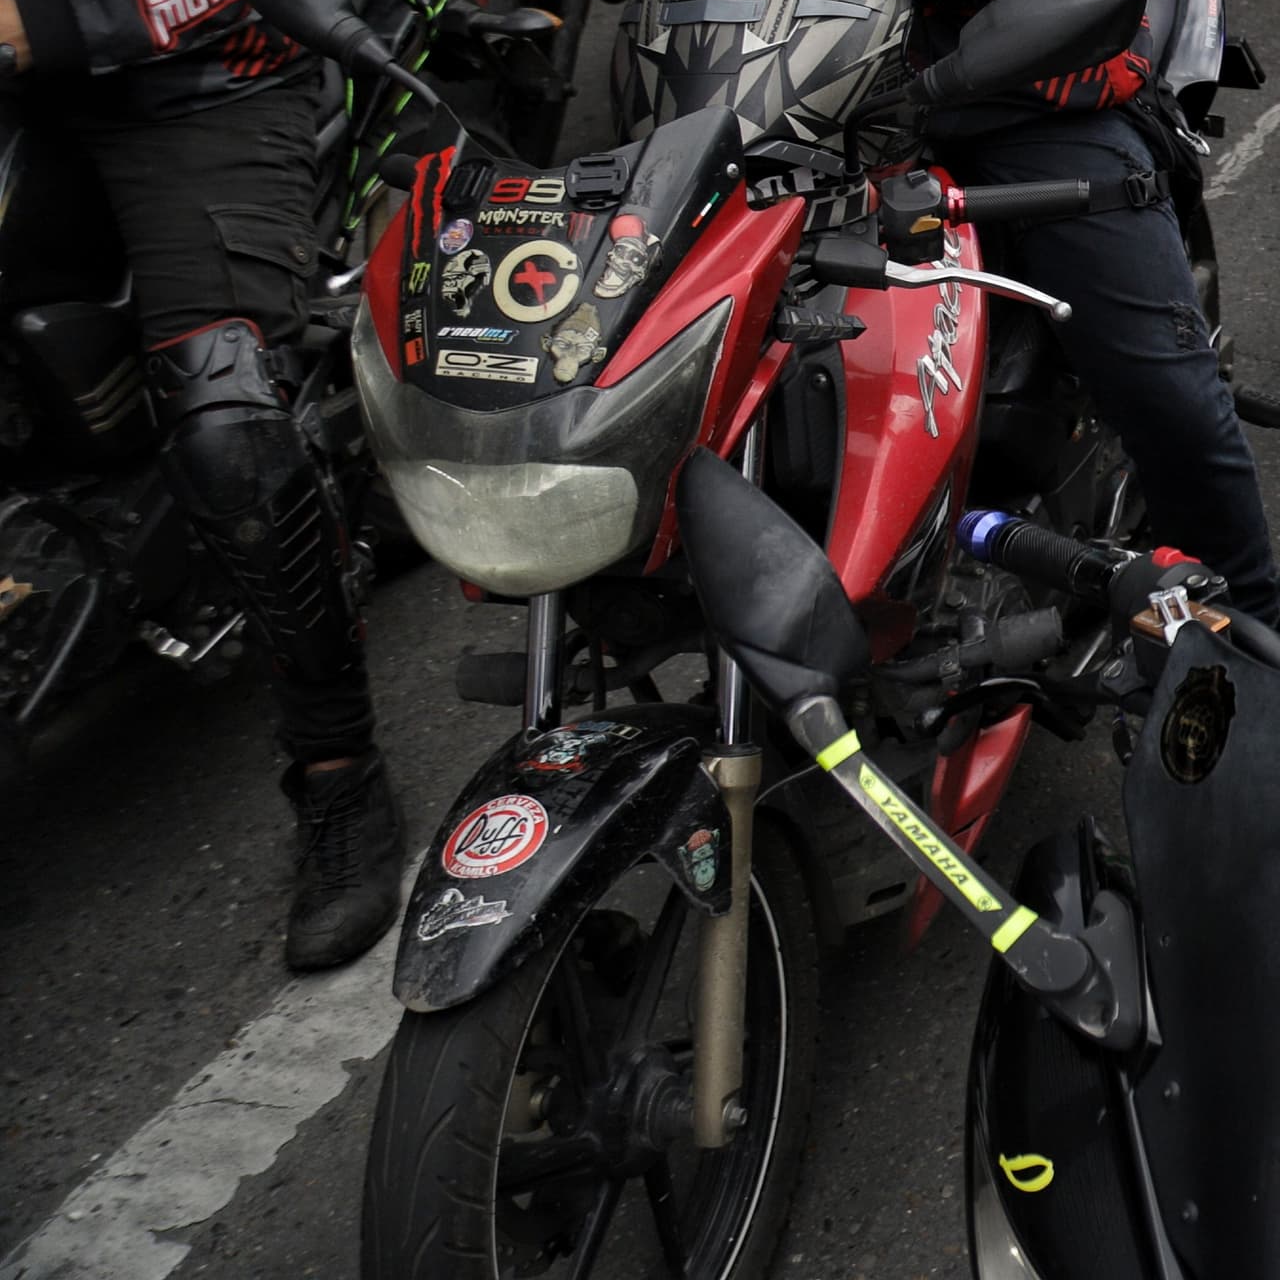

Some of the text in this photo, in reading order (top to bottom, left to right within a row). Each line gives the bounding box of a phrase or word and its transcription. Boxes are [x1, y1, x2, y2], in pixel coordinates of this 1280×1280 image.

[488, 177, 567, 204] 99
[484, 796, 546, 824] CERVEZA
[455, 813, 529, 856] Duff
[880, 796, 970, 886] YAMAHA
